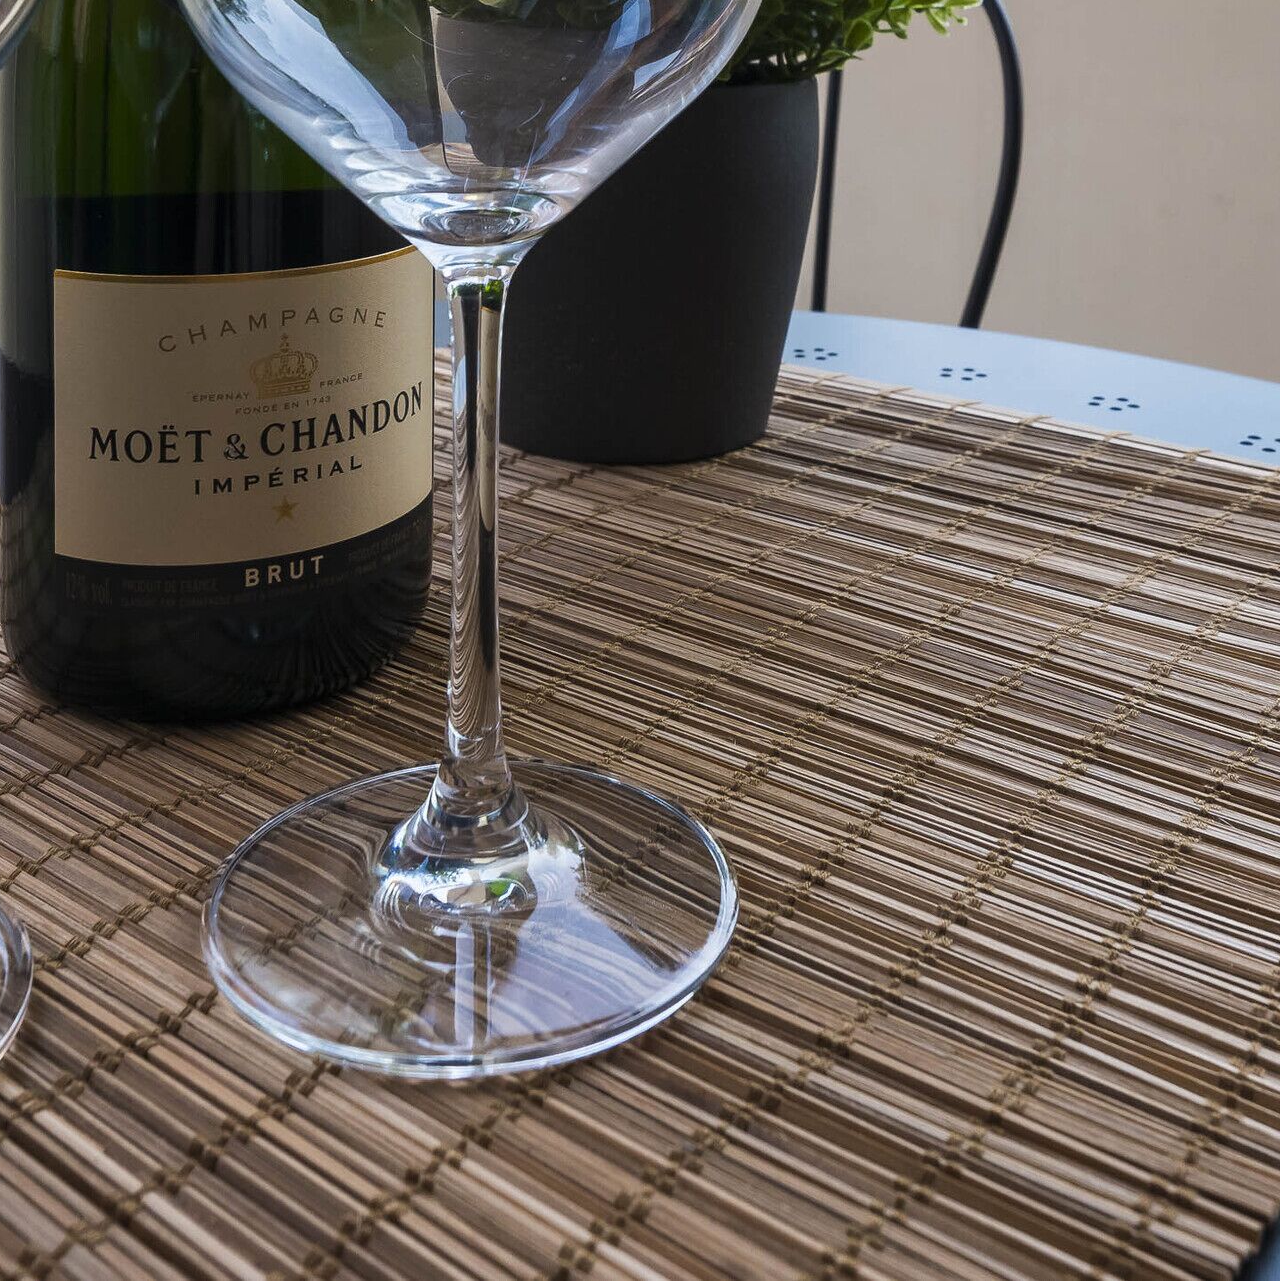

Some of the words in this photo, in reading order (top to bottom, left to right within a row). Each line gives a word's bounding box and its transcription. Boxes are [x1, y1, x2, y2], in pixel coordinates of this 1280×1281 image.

[158, 305, 387, 354] CHAMPAGNE
[319, 372, 364, 389] FRANCE
[284, 400, 300, 411] EN
[306, 394, 332, 407] 1743
[88, 424, 212, 465] MOËT
[223, 432, 250, 461] &
[260, 380, 424, 457] CHANDON
[194, 454, 363, 496] IMPÉRIAL
[244, 554, 324, 588] BRUT
